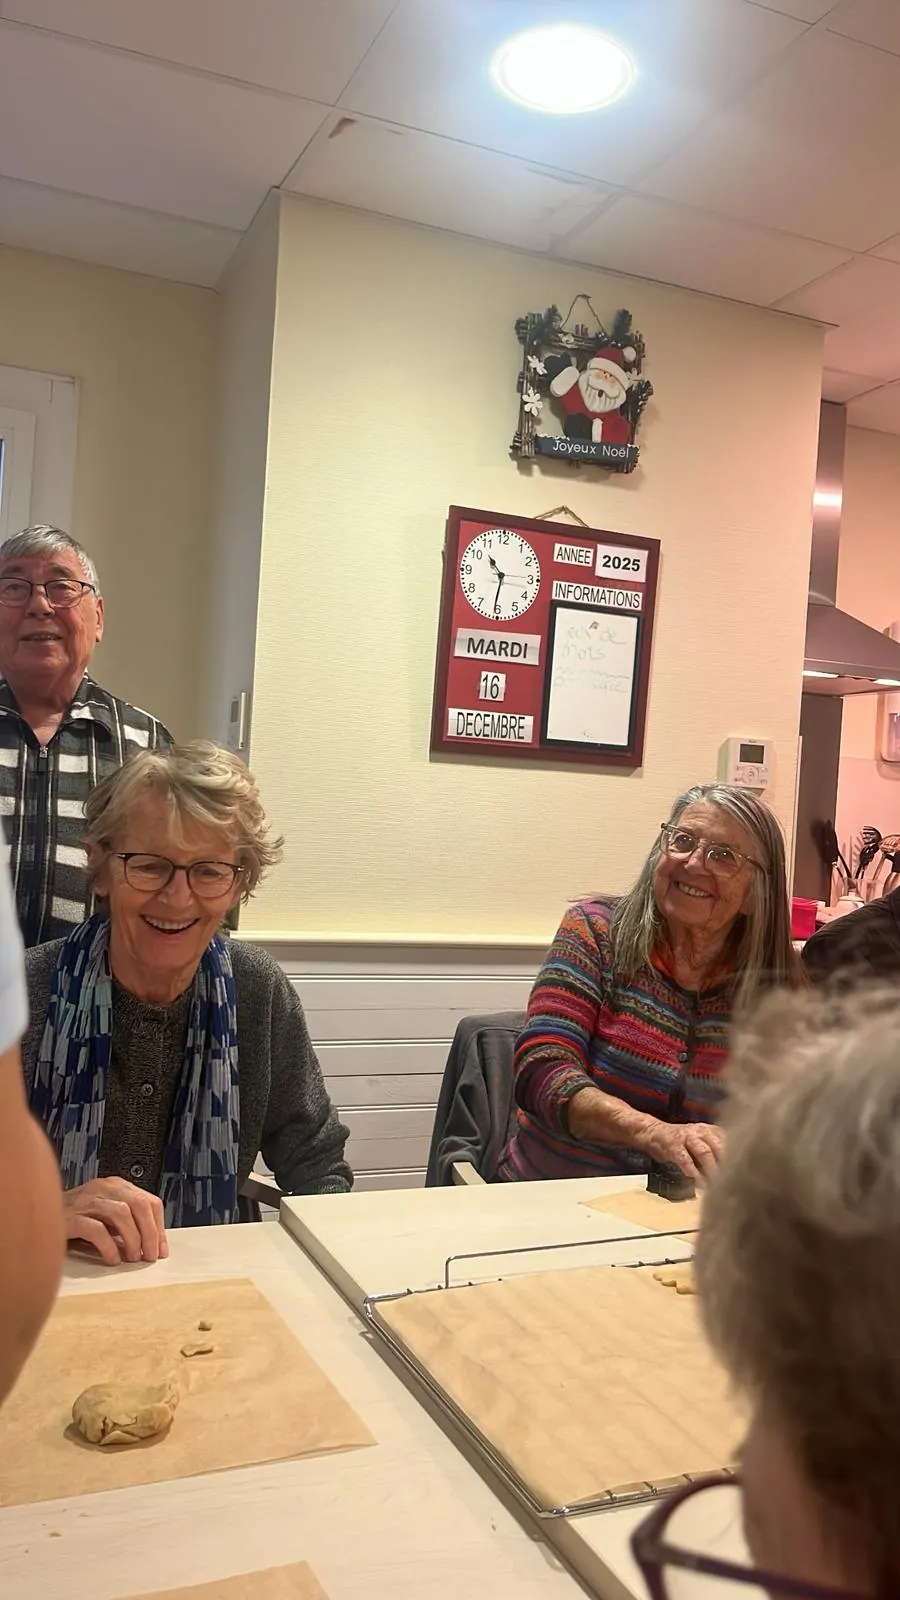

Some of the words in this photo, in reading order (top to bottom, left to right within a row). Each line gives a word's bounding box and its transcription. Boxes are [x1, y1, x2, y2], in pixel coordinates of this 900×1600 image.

[553, 440, 597, 454] Joyeux
[602, 445, 629, 458] Noël
[482, 538, 493, 549] 11
[497, 534, 510, 545] 12
[518, 543, 523, 554] 1
[471, 549, 483, 560] 10
[556, 546, 591, 565] ANNEE
[602, 554, 641, 572] 2025
[524, 556, 533, 567] 2
[465, 564, 473, 575] 9
[526, 574, 534, 585] 3
[468, 582, 476, 593] 8
[520, 590, 528, 601] 4
[554, 582, 641, 609] INFORMATIONS
[477, 597, 485, 607] 7
[511, 601, 519, 612] 5
[494, 604, 502, 615] 6
[467, 637, 528, 659] MARDI
[482, 673, 500, 699] 16
[456, 711, 525, 740] DECEMBRE
